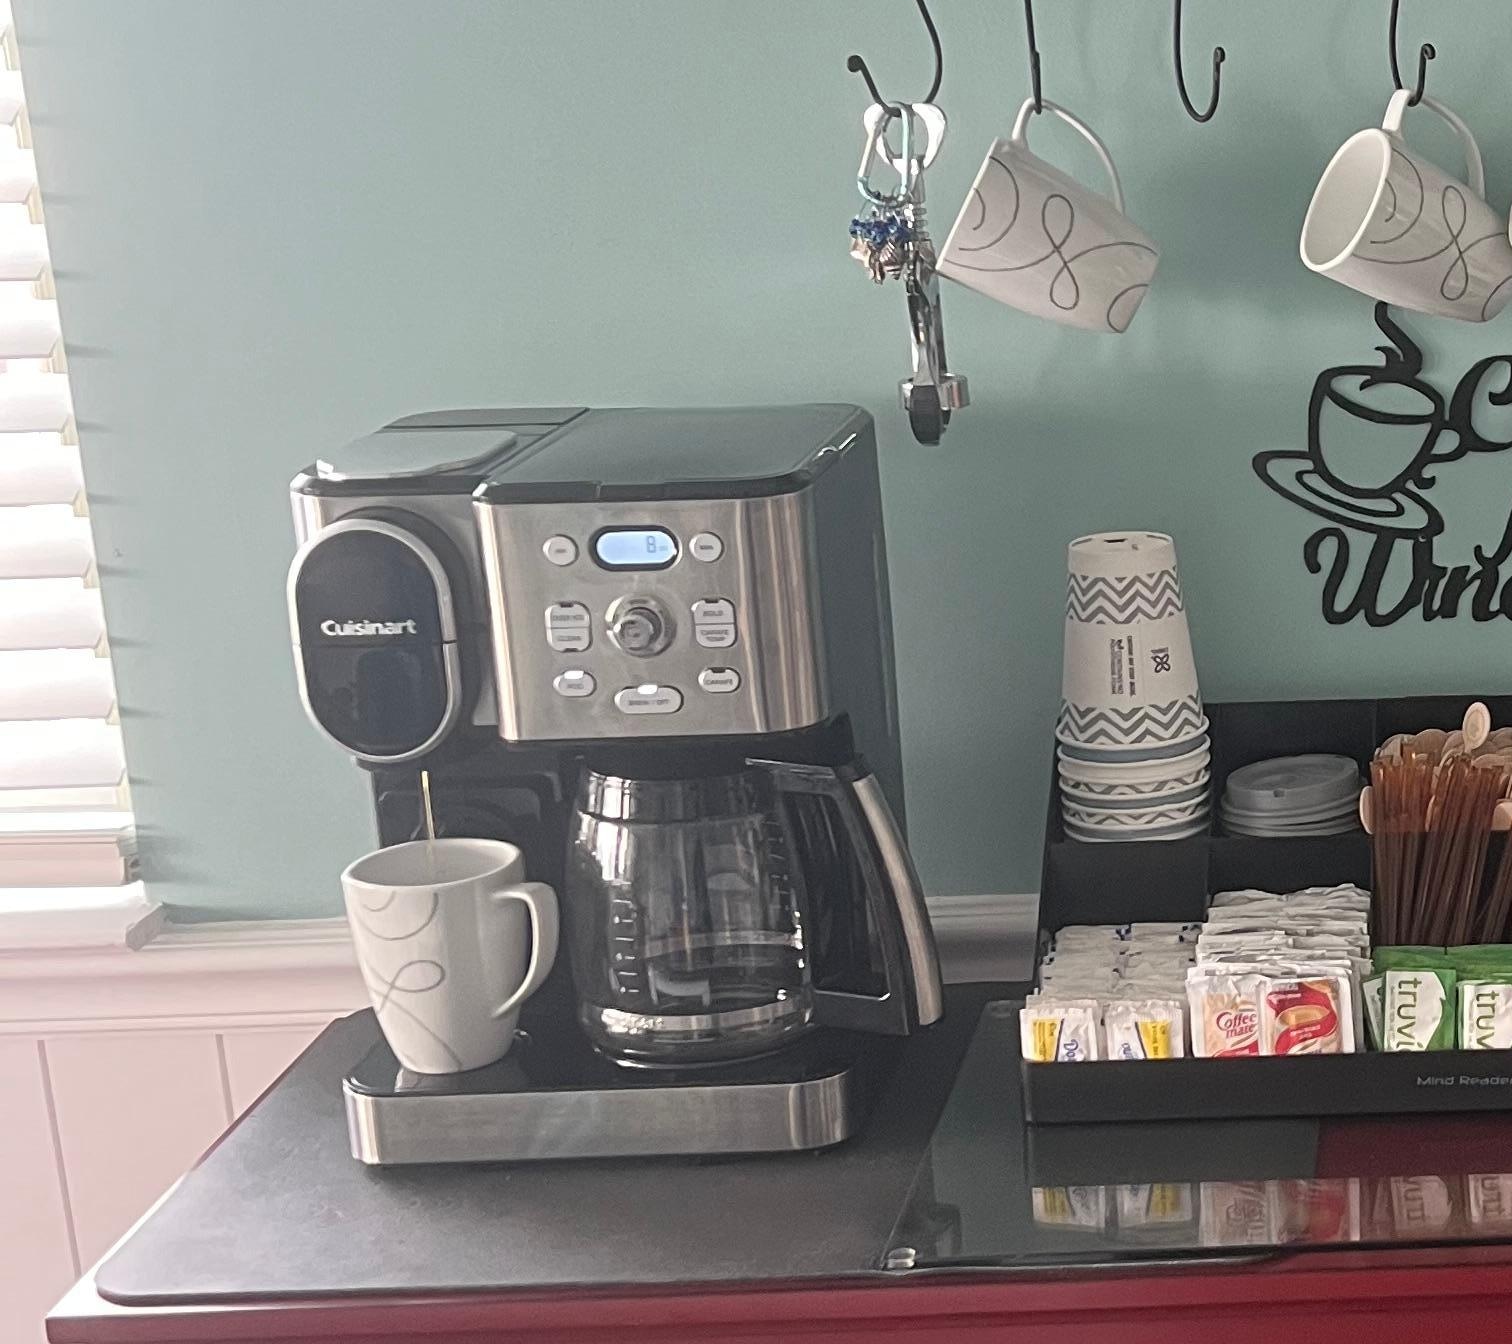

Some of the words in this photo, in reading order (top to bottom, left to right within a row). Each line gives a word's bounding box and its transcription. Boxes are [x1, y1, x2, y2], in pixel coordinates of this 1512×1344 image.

[320, 619, 417, 636] Cuisinart
[1226, 1023, 1255, 1039] mate
[1416, 1075, 1455, 1086] Mind
